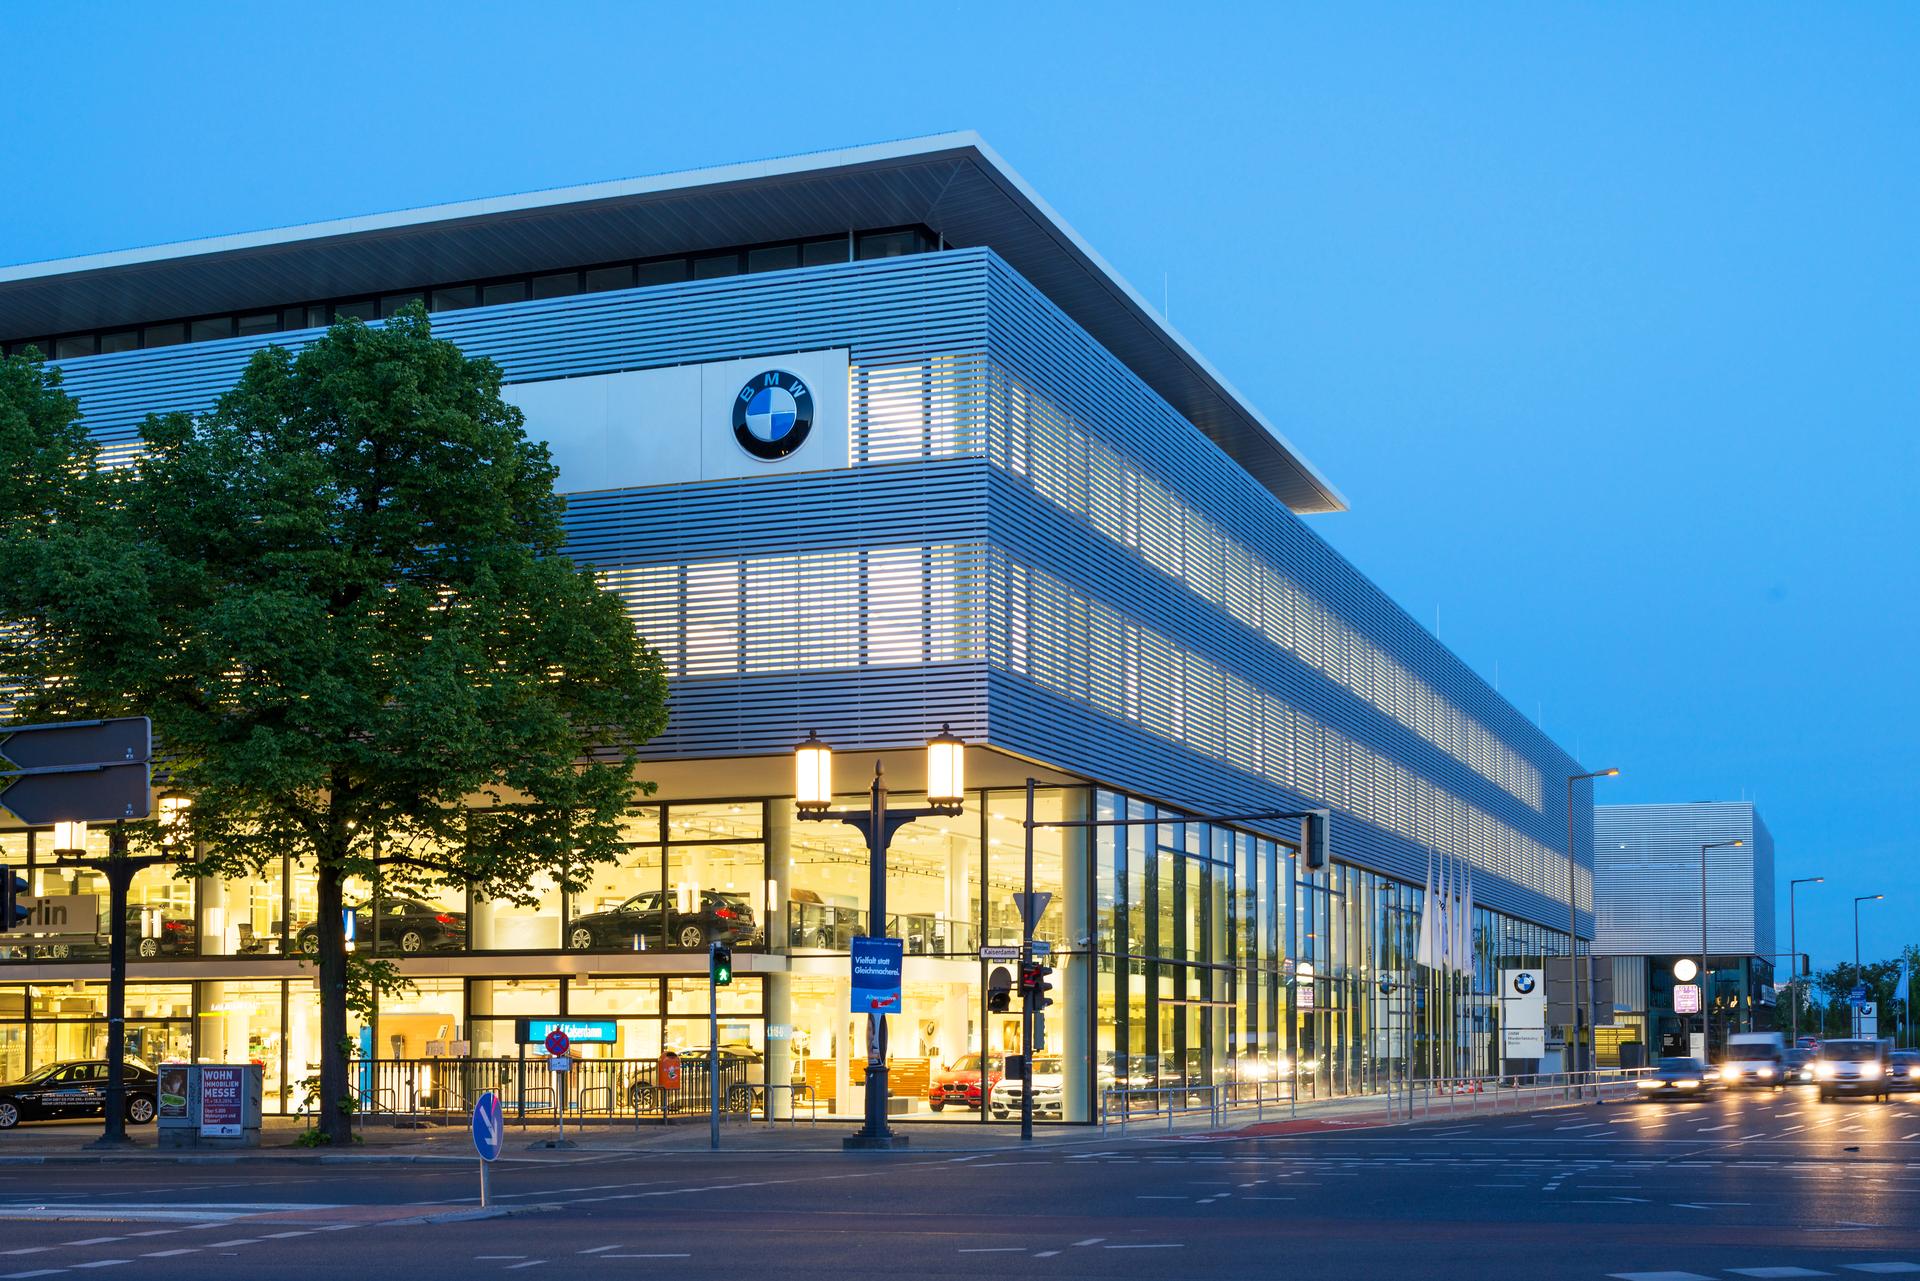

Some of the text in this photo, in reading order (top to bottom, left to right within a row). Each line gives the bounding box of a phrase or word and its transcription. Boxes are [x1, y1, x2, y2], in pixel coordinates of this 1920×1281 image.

[740, 373, 806, 402] BMW
[855, 956, 890, 966] Vielfalt statt
[204, 1070, 233, 1080] WOHN
[204, 1088, 236, 1098] MESSE
